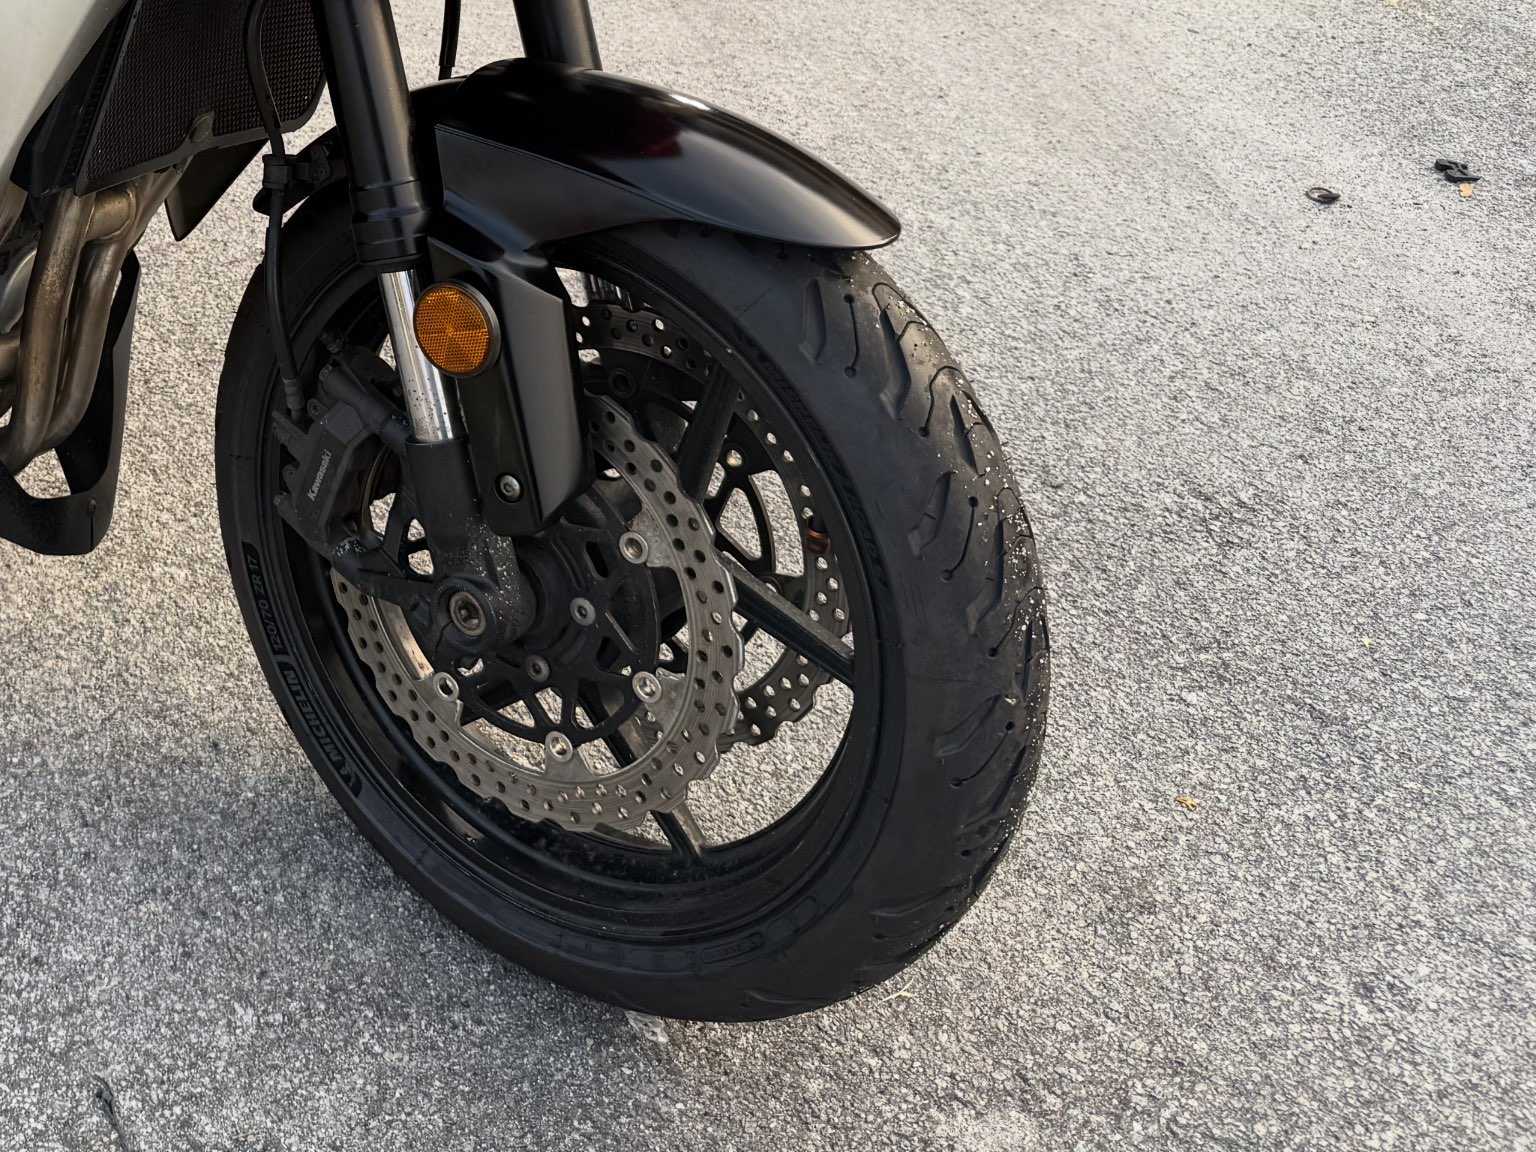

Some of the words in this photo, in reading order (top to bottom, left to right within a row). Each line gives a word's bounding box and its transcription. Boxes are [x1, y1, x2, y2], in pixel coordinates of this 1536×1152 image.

[307, 448, 332, 501] Kawasaki
[247, 553, 258, 569] 17
[251, 574, 265, 595] ZR
[258, 599, 283, 651] 120/70
[283, 669, 342, 762] MICHELIN
